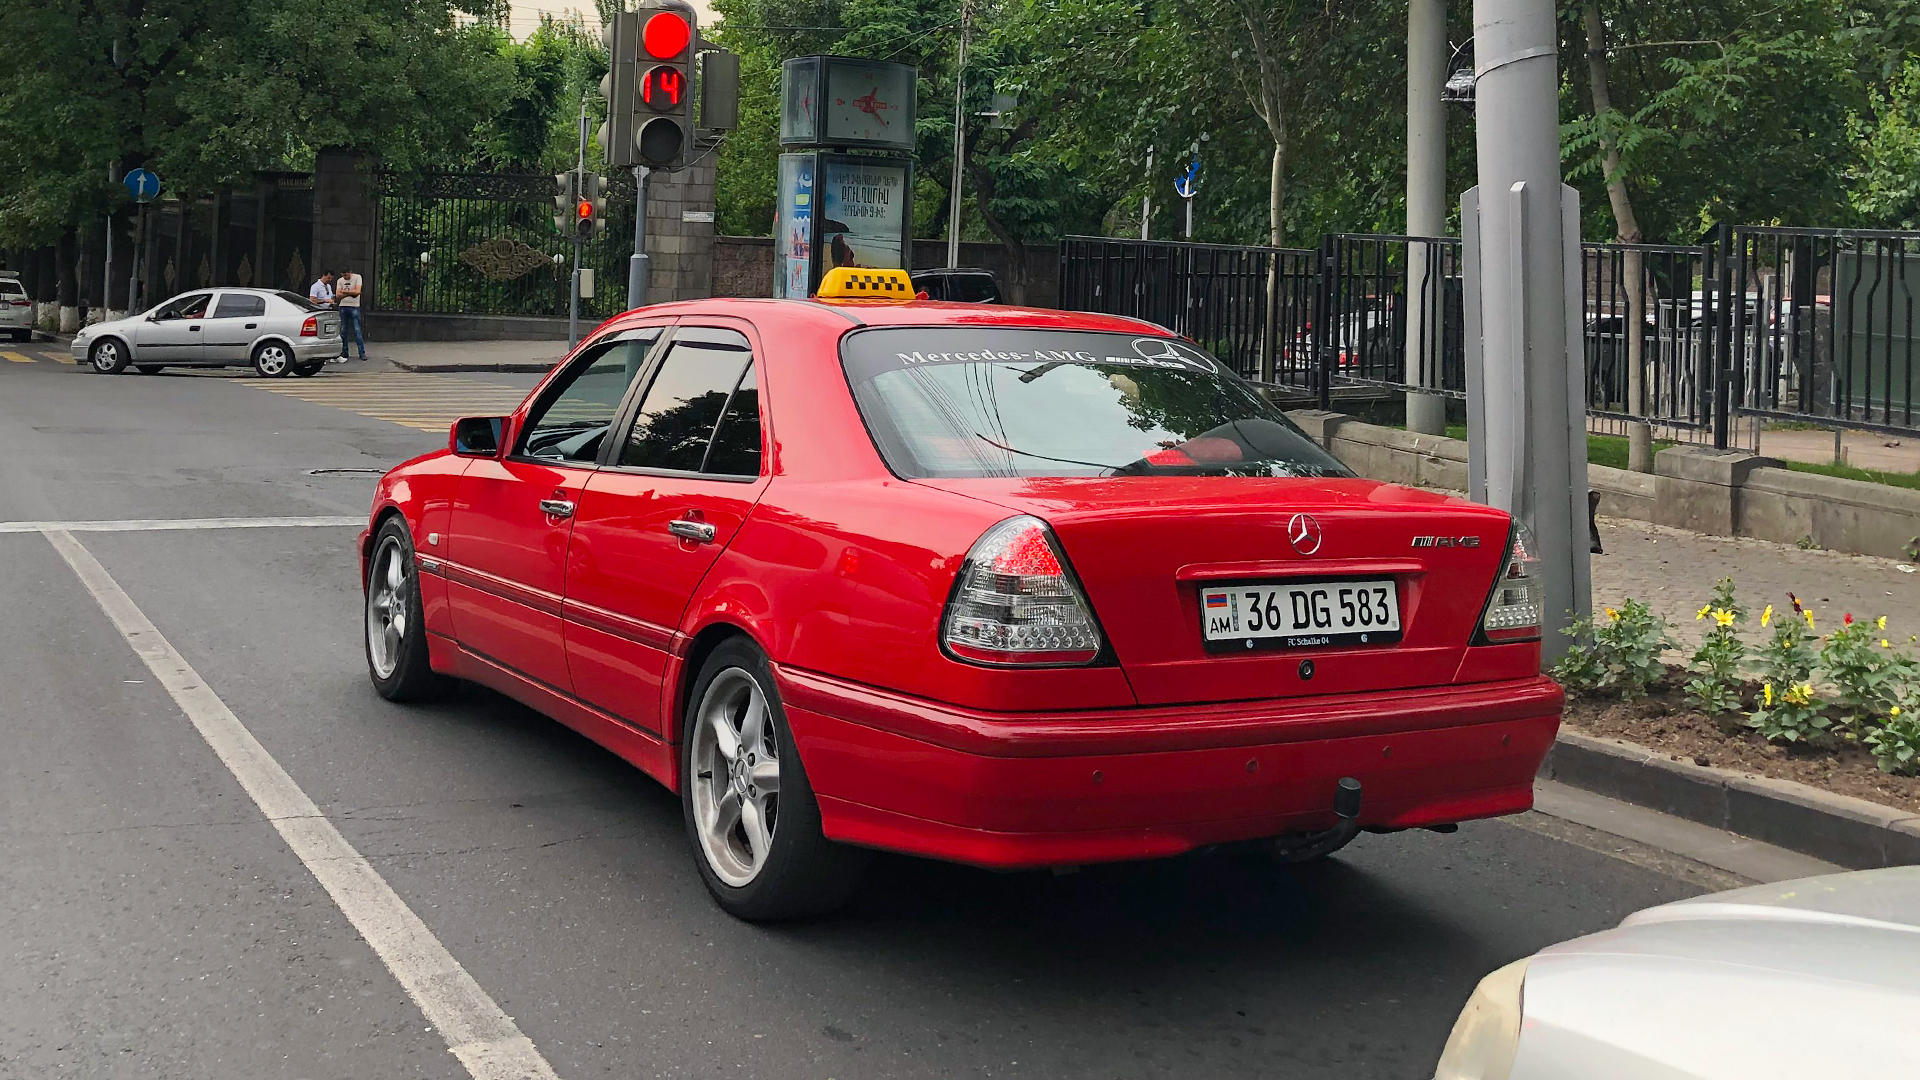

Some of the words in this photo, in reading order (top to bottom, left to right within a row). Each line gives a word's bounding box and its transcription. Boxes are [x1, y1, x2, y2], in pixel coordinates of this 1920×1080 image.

[644, 72, 678, 104] 14
[896, 348, 1097, 364] Mercedes-AMG
[1245, 592, 1281, 632] 36
[1289, 590, 1332, 630] DG
[1338, 588, 1390, 627] 583
[1210, 616, 1231, 634] AM
